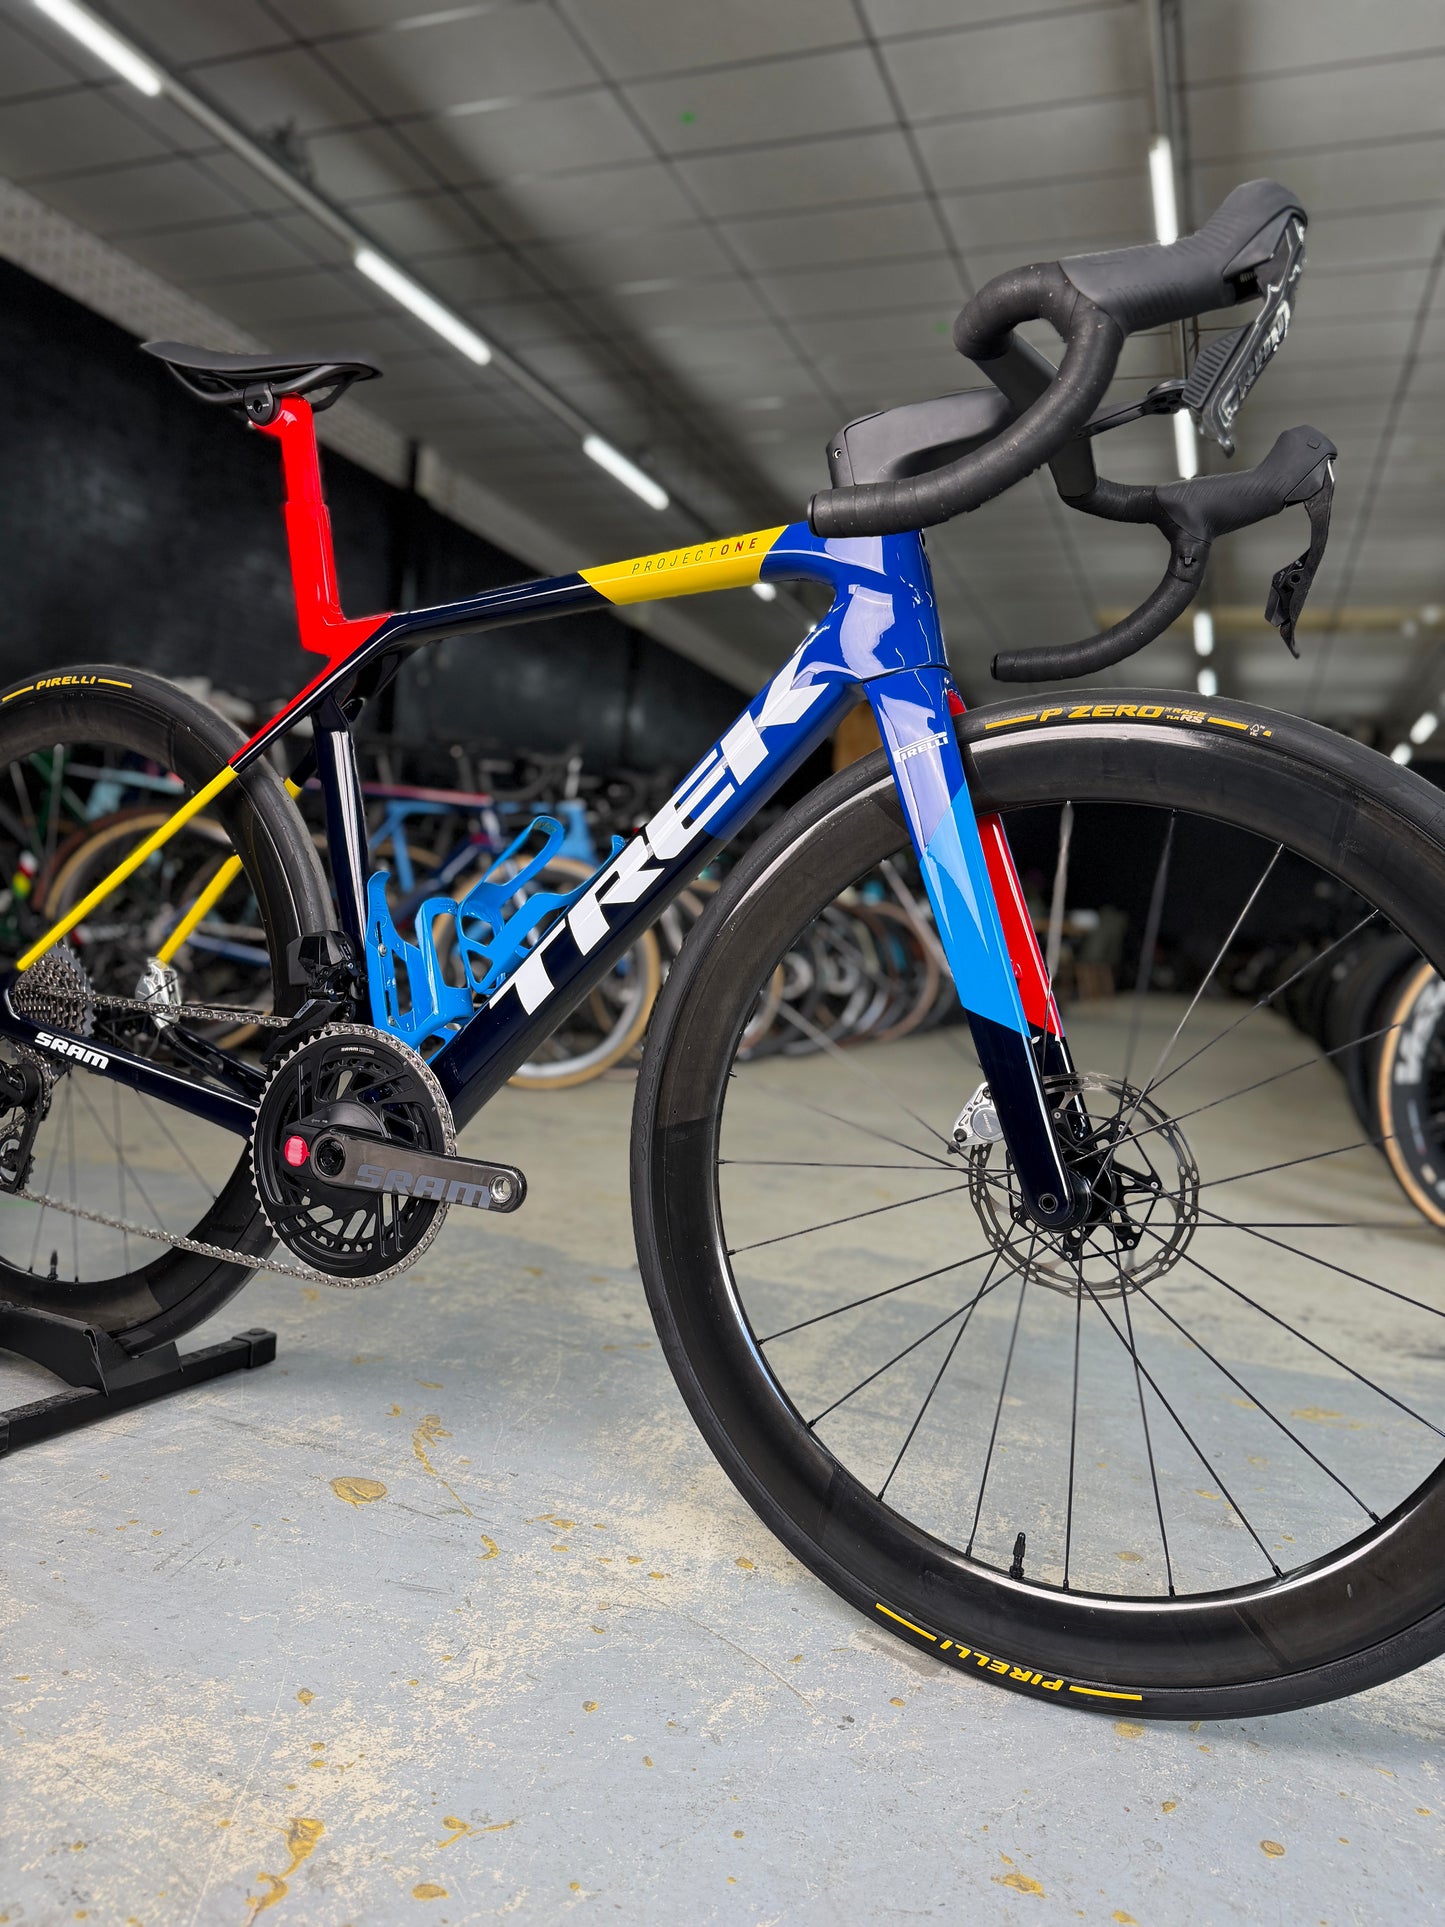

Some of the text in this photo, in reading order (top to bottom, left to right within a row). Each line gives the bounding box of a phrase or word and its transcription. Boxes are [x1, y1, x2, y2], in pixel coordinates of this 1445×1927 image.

[36, 675, 97, 690] PIRELLI
[1039, 707, 1064, 722] P
[1067, 704, 1166, 719] ZERO
[1179, 714, 1205, 724] RS
[892, 731, 949, 764] PIRELLI
[488, 646, 831, 1016] TREK
[34, 1031, 110, 1070] SRAM
[354, 1163, 493, 1210] SRAM
[939, 1638, 1065, 1692] PIRELLI
